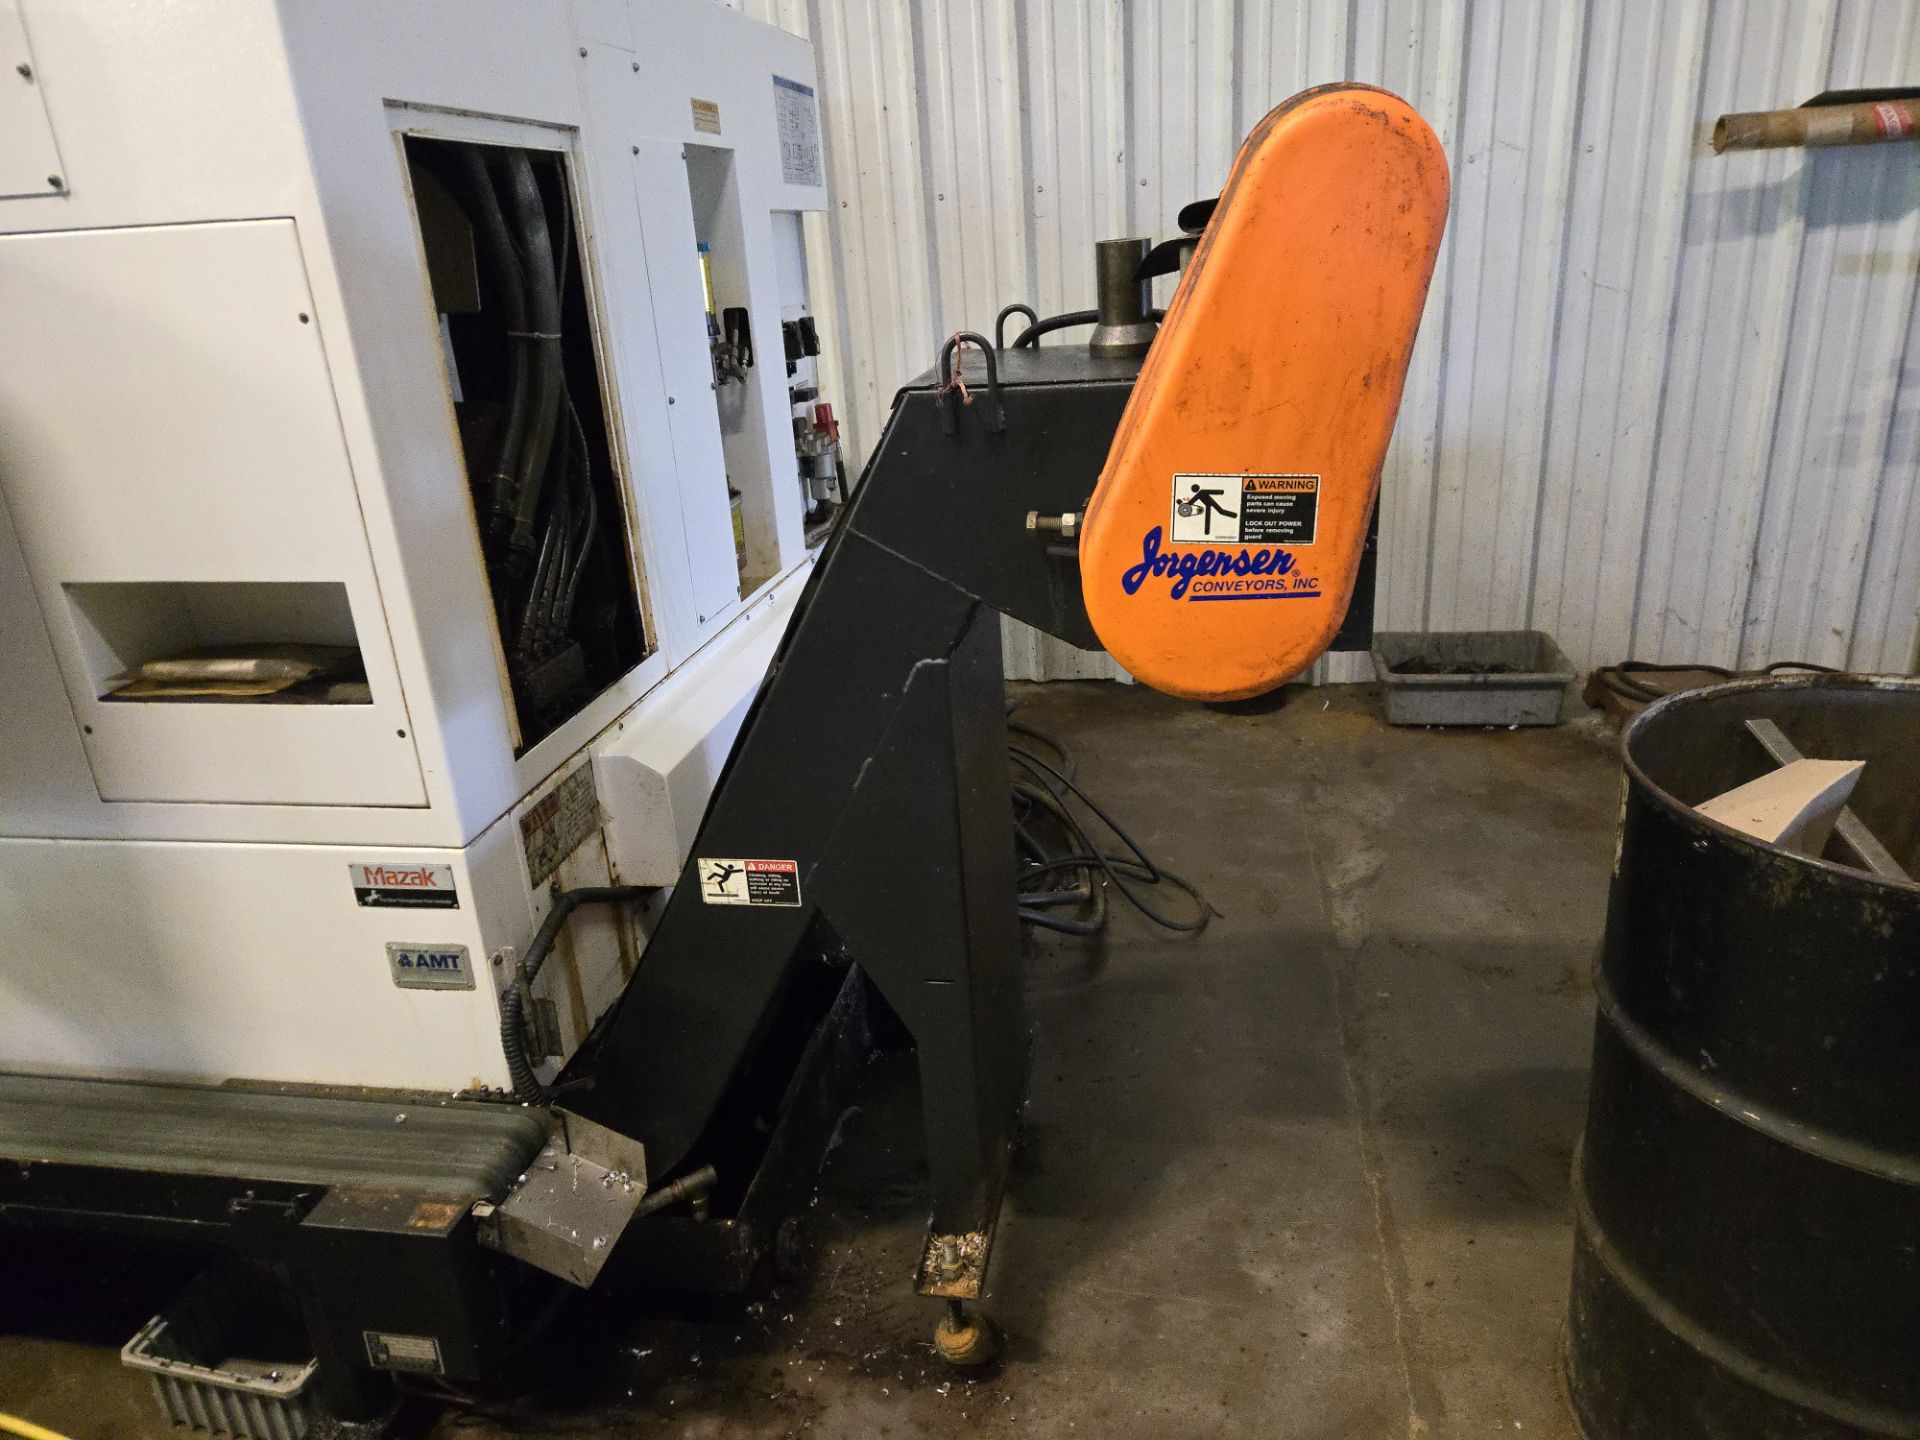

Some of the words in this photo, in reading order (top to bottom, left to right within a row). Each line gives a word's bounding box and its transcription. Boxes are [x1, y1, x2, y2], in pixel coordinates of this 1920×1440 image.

[1259, 480, 1314, 490] WARNING
[1121, 525, 1297, 600] Jorgensen
[1192, 579, 1288, 593] CONVEYORS,
[1292, 577, 1319, 589] INC
[758, 863, 792, 871] DANGER
[363, 866, 437, 887] Mazak
[416, 954, 460, 969] AMT
